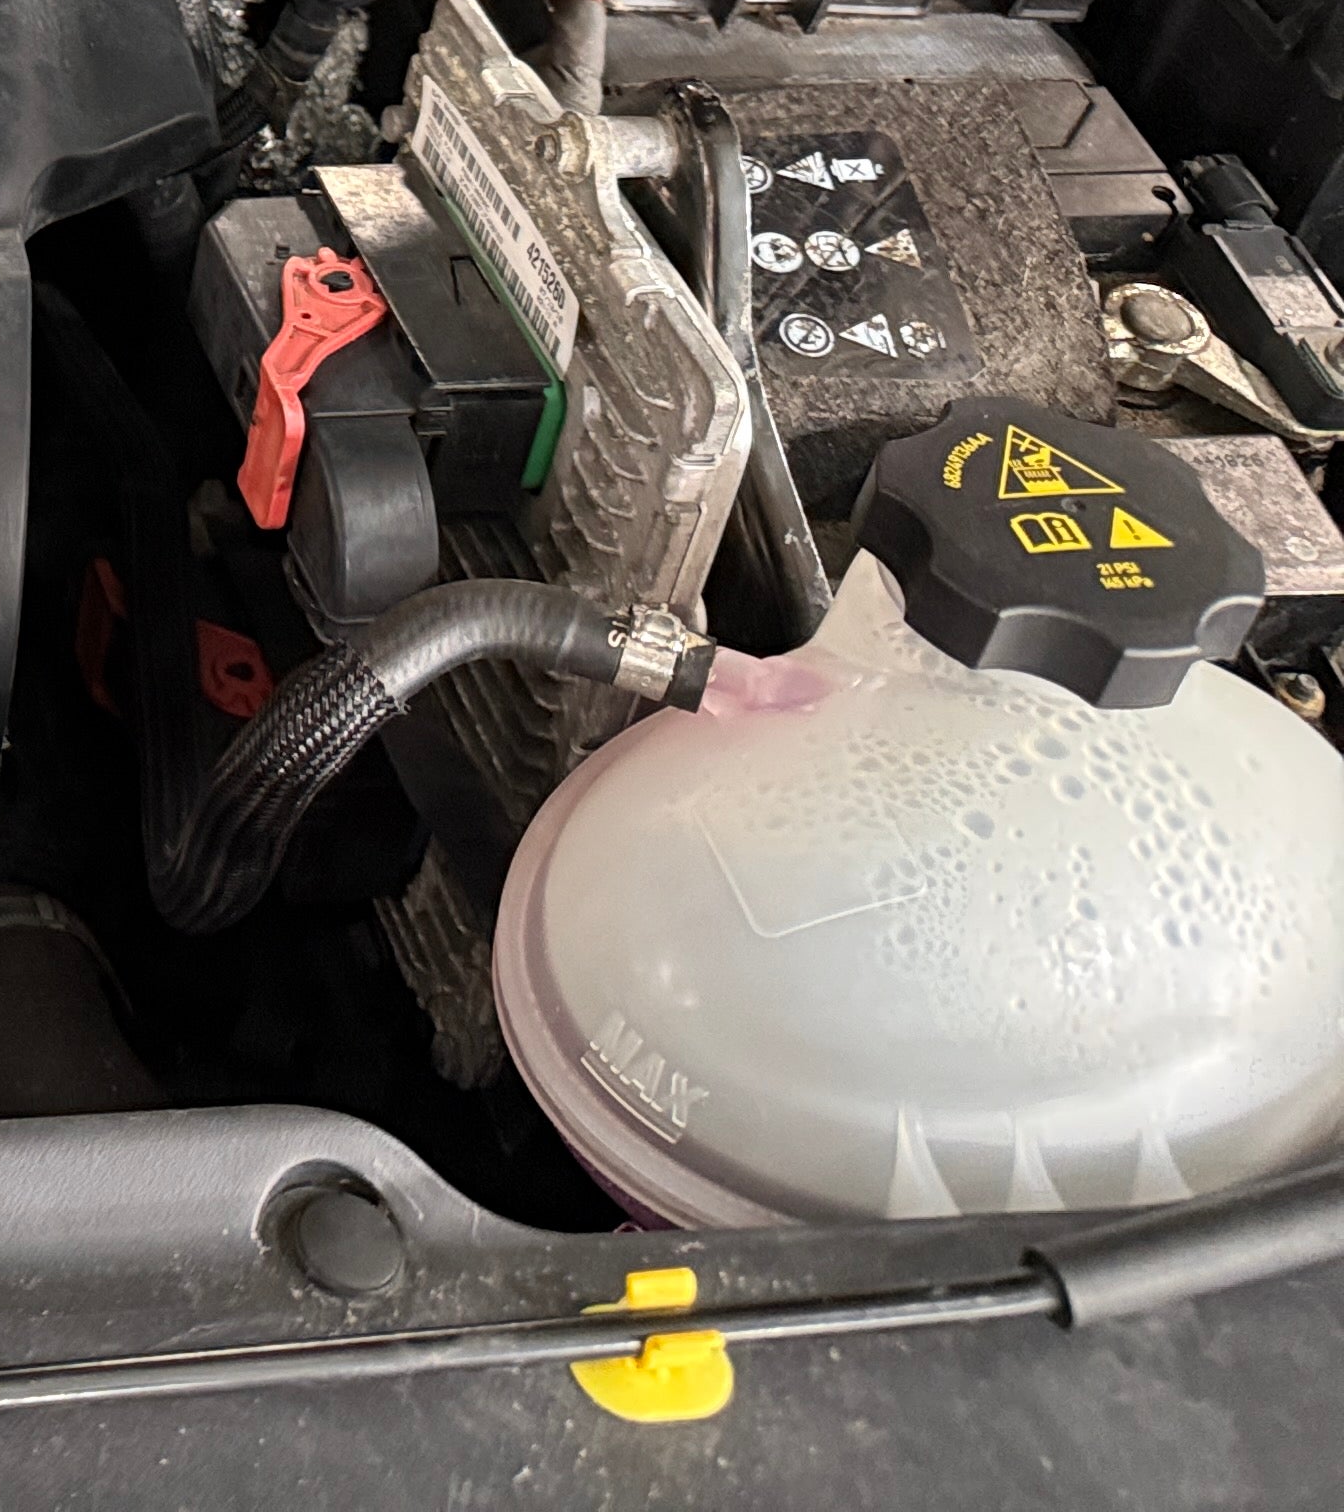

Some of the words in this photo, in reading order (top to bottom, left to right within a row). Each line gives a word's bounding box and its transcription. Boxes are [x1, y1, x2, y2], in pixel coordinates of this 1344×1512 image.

[526, 242, 566, 309] 4215260
[1112, 562, 1141, 575] PSI
[588, 1013, 710, 1129] MAX
